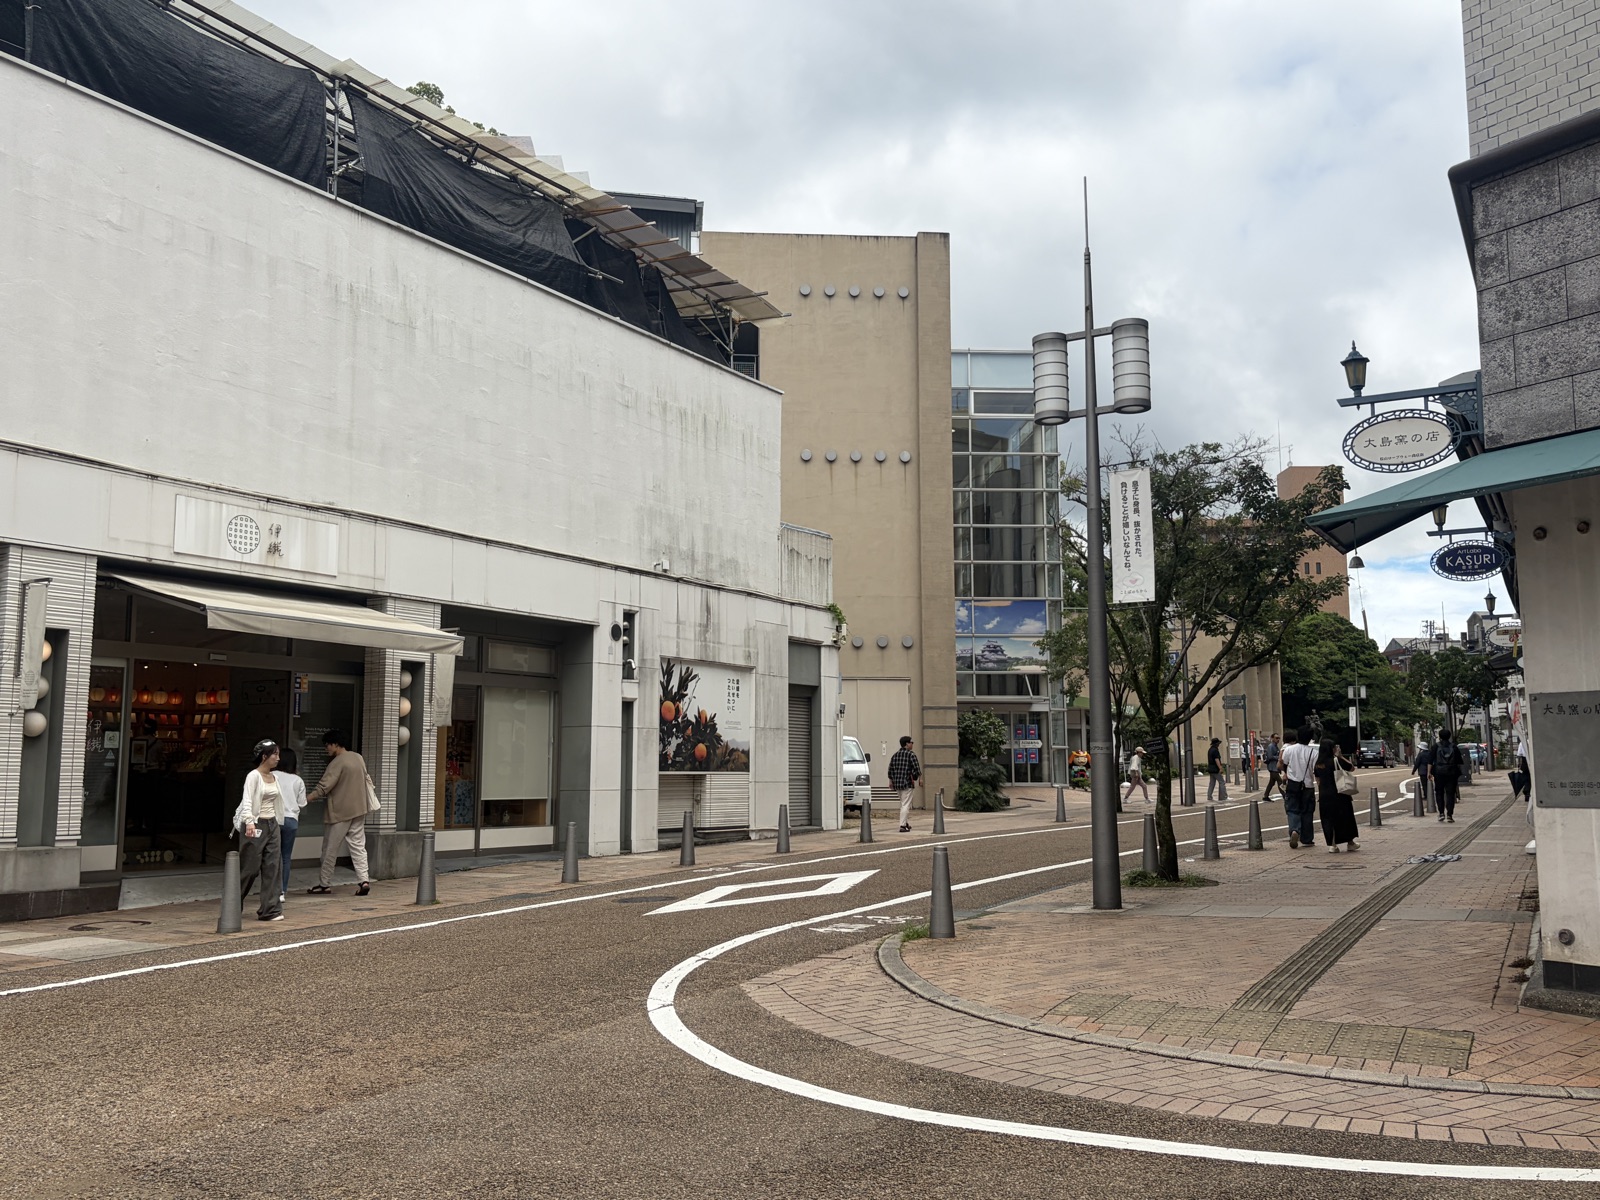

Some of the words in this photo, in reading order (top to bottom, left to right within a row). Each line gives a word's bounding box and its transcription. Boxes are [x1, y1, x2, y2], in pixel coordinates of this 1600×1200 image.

[1363, 431, 1440, 449] 大島窯の店
[1445, 553, 1496, 567] KASURI
